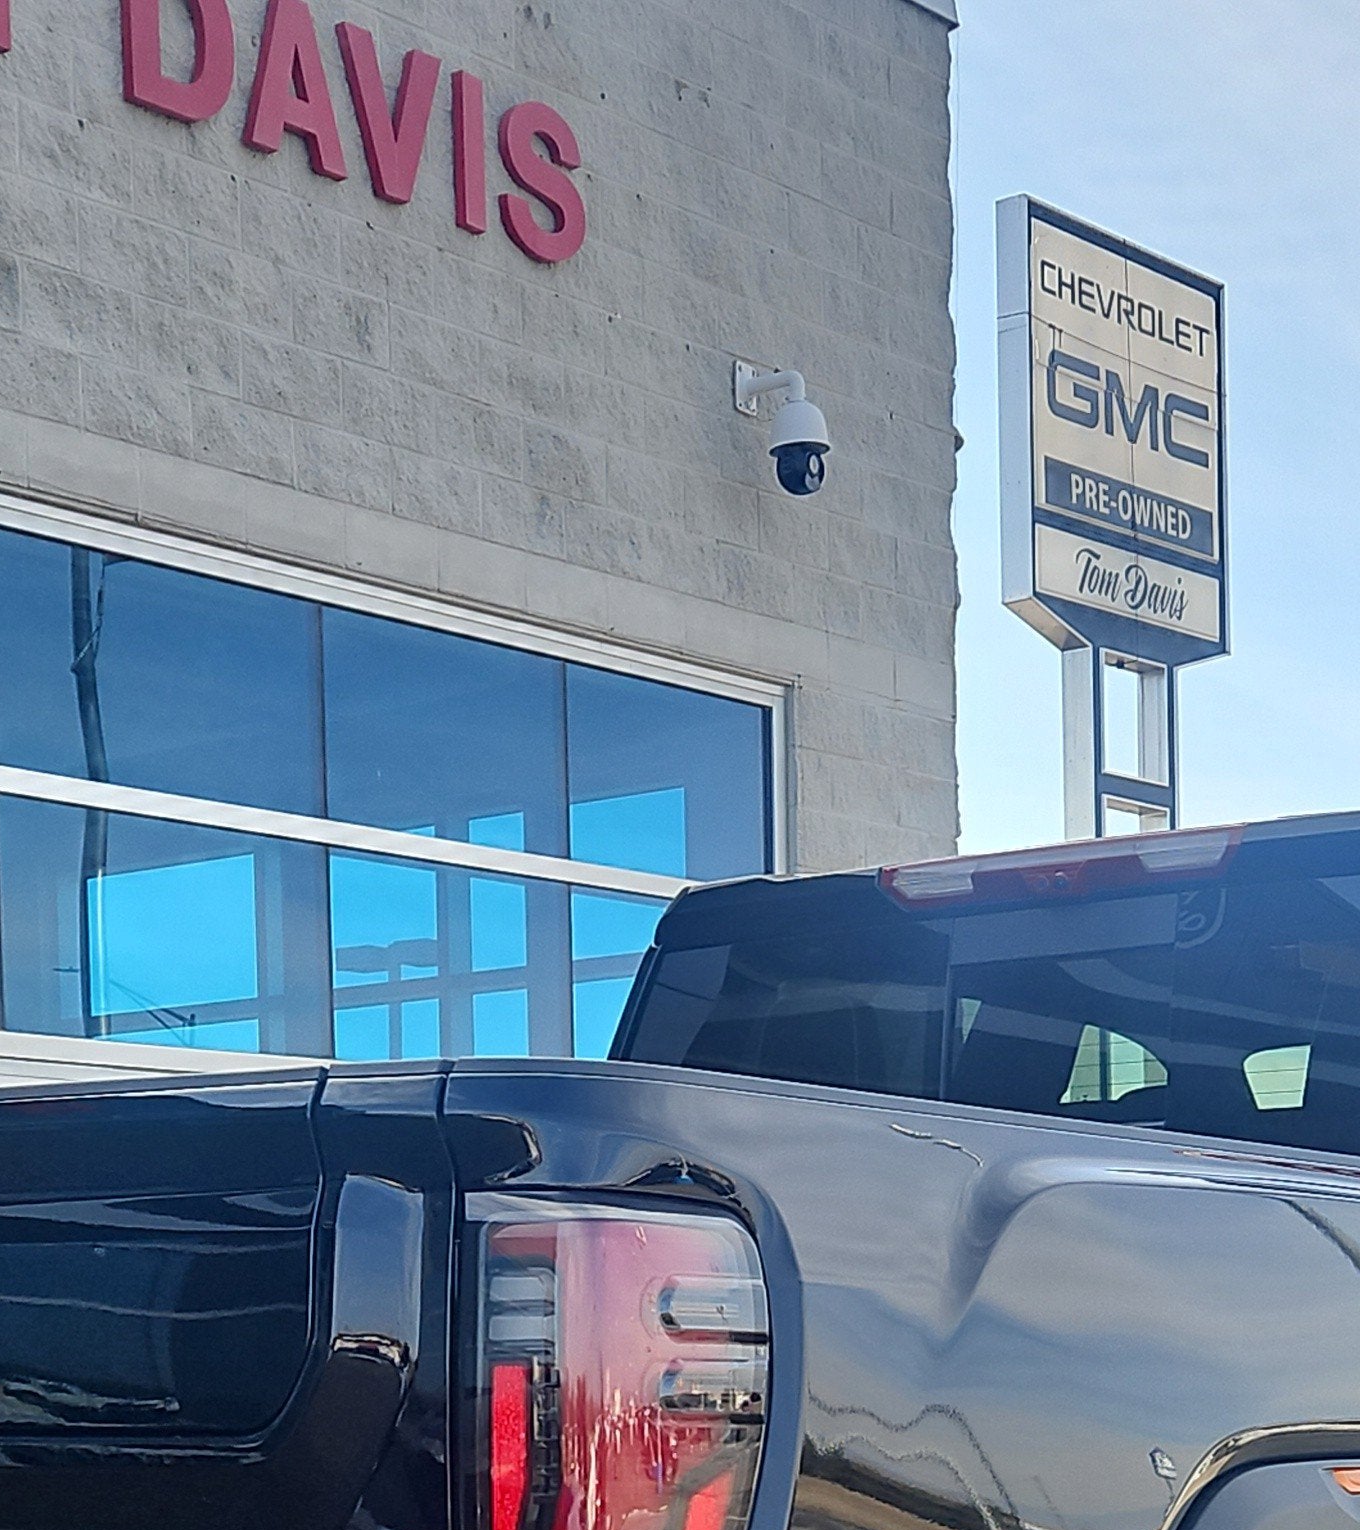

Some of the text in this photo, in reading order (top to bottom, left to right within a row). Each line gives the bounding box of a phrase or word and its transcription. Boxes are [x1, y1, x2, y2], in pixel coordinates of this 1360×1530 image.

[121, 0, 587, 265] DAVIS
[1039, 258, 1210, 358] CHEVROLET
[1046, 348, 1210, 470] GMC
[1070, 472, 1193, 542] PRE-OWNED
[1075, 546, 1189, 622] Tom Davis
